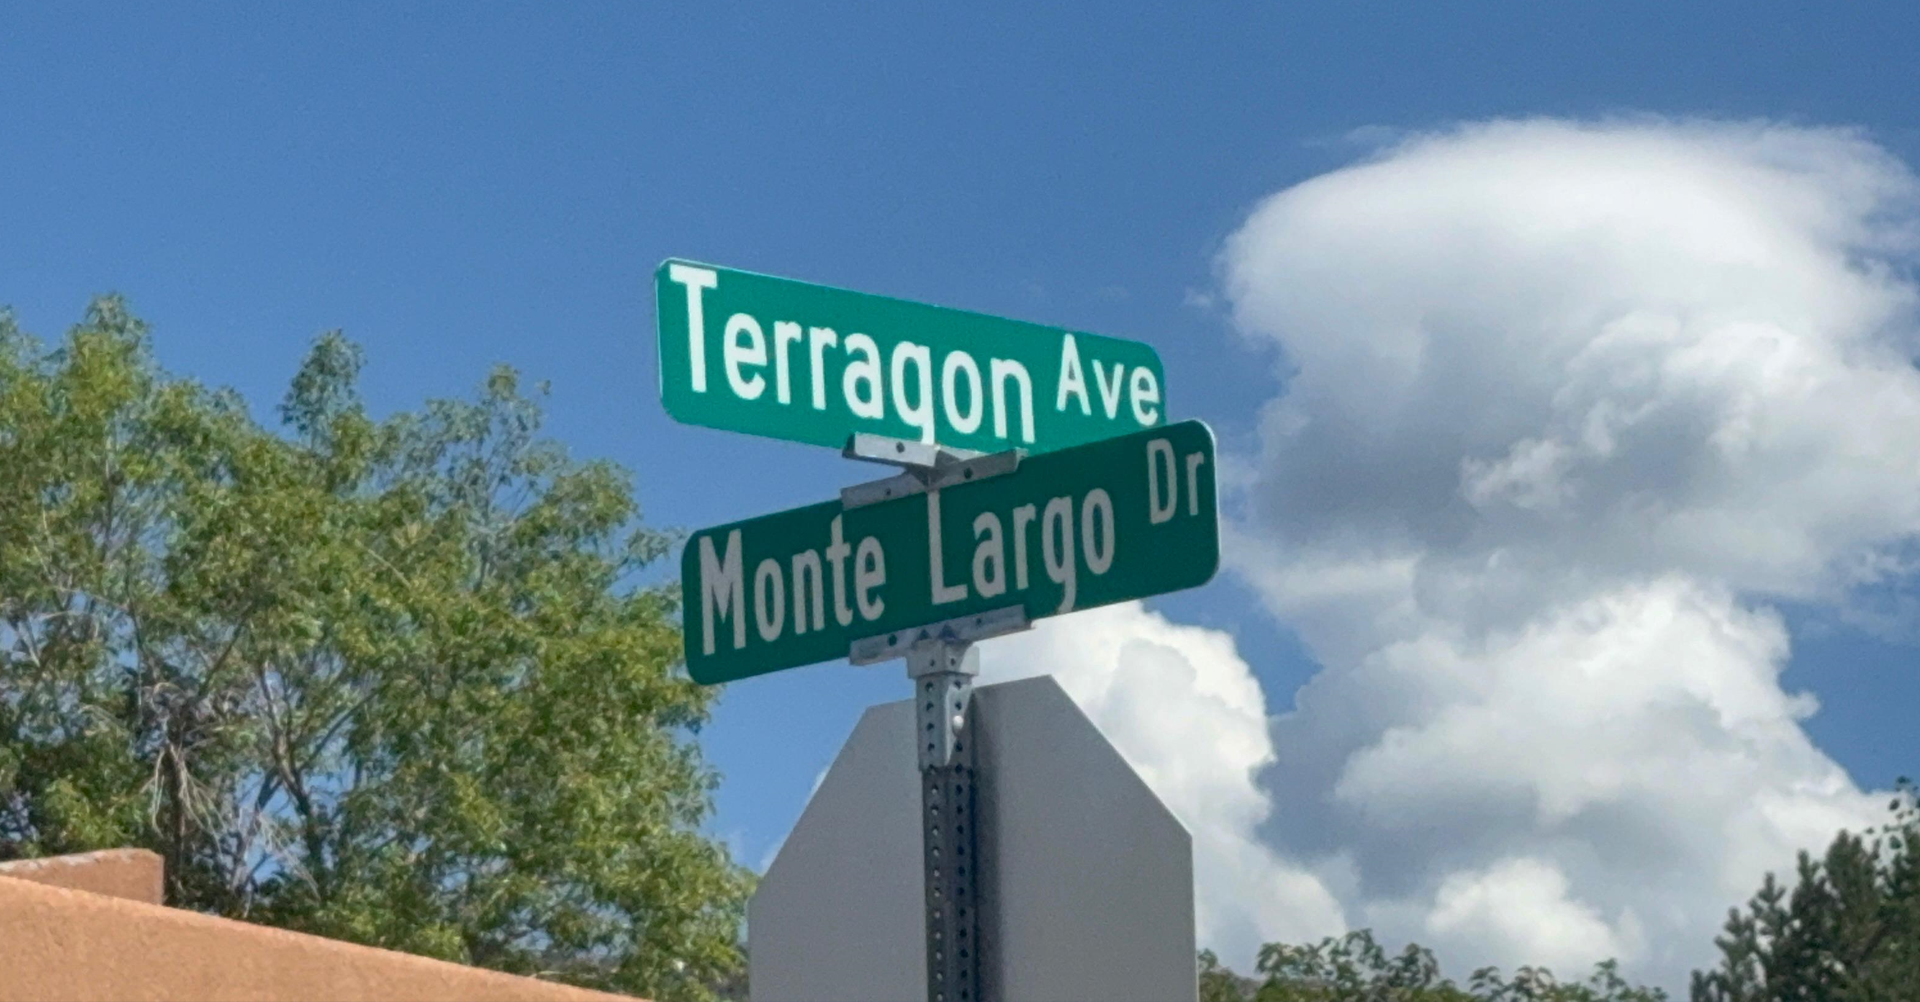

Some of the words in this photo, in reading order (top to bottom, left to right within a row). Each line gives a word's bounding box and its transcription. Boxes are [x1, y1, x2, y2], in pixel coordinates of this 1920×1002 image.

[670, 264, 1035, 445] Terragon
[1056, 333, 1160, 426] Ave
[701, 513, 886, 656] Monte
[927, 488, 1116, 615] Largo
[1147, 438, 1204, 525] Dr
